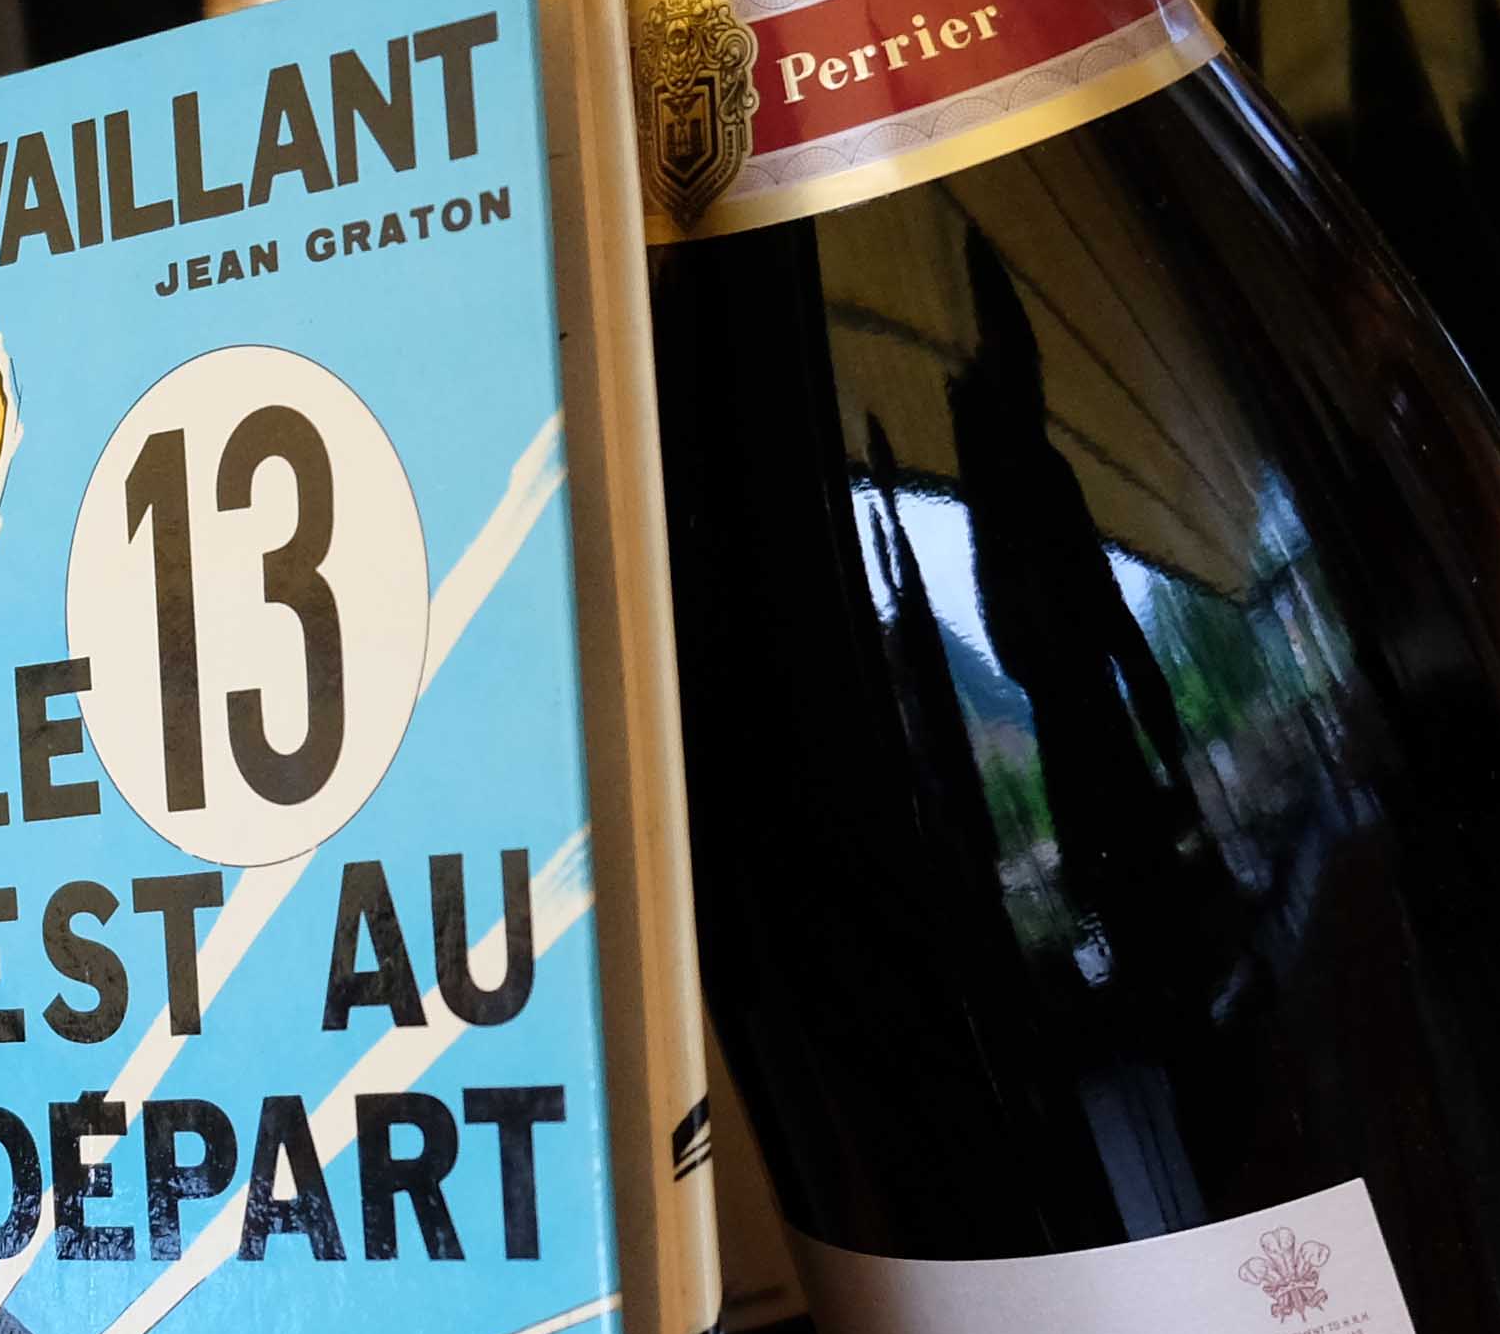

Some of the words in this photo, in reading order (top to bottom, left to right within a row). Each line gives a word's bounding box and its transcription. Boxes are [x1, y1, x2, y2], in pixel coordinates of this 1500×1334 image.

[155, 240, 279, 296] JEAN
[305, 186, 511, 262] GRATON
[125, 404, 345, 813] 13
[322, 847, 536, 1033] AU
